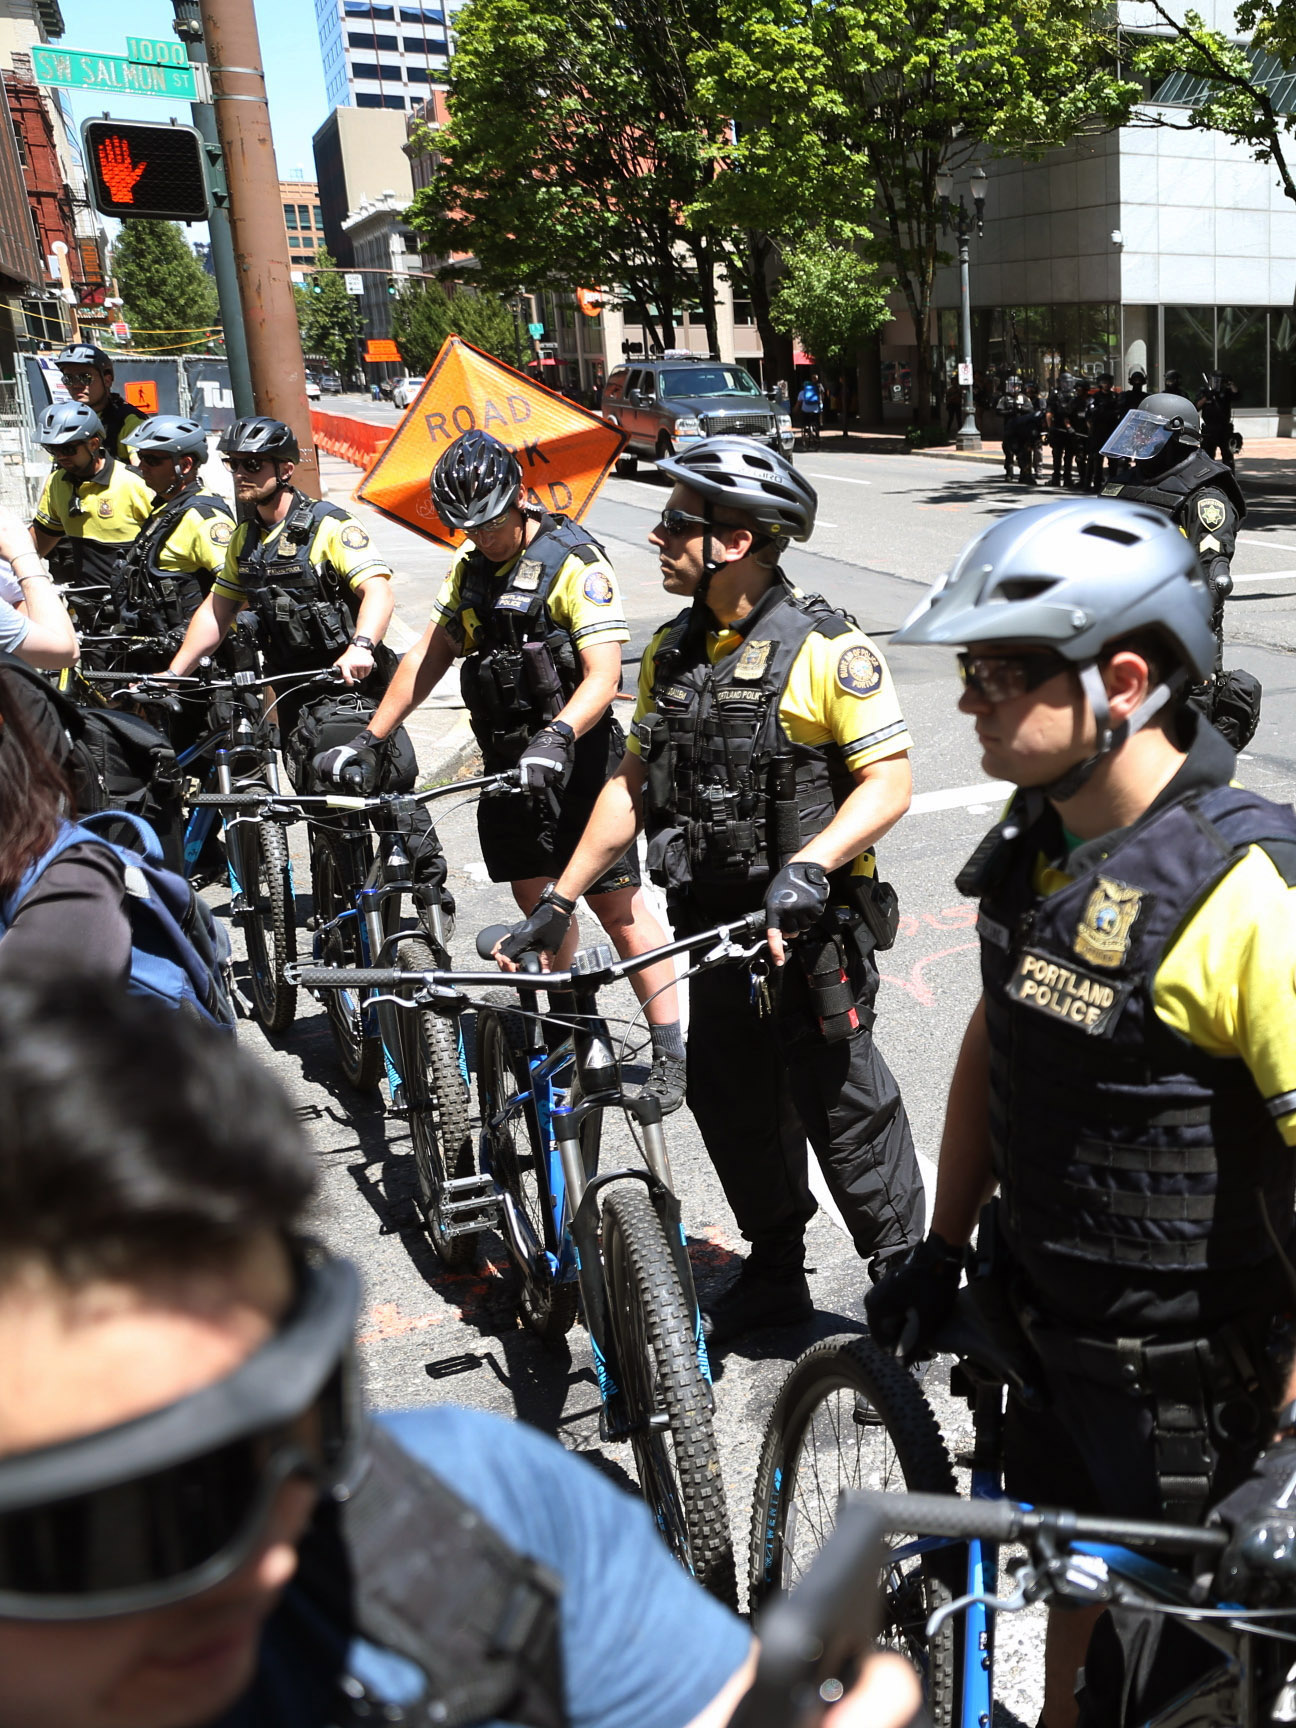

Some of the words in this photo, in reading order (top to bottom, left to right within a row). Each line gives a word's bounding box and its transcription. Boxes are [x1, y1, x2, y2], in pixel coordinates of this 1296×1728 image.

[38, 52, 72, 81] SW
[80, 57, 167, 91] SALMON
[173, 74, 189, 88] ST
[129, 39, 185, 65] 1000
[424, 395, 532, 443] ROAD
[718, 691, 742, 700] ORTLAND
[1019, 979, 1102, 1026] POLICE
[1021, 955, 1115, 1009] PORTLAND
[759, 1427, 779, 1500] RACING
[750, 1504, 763, 1586] RALPH
